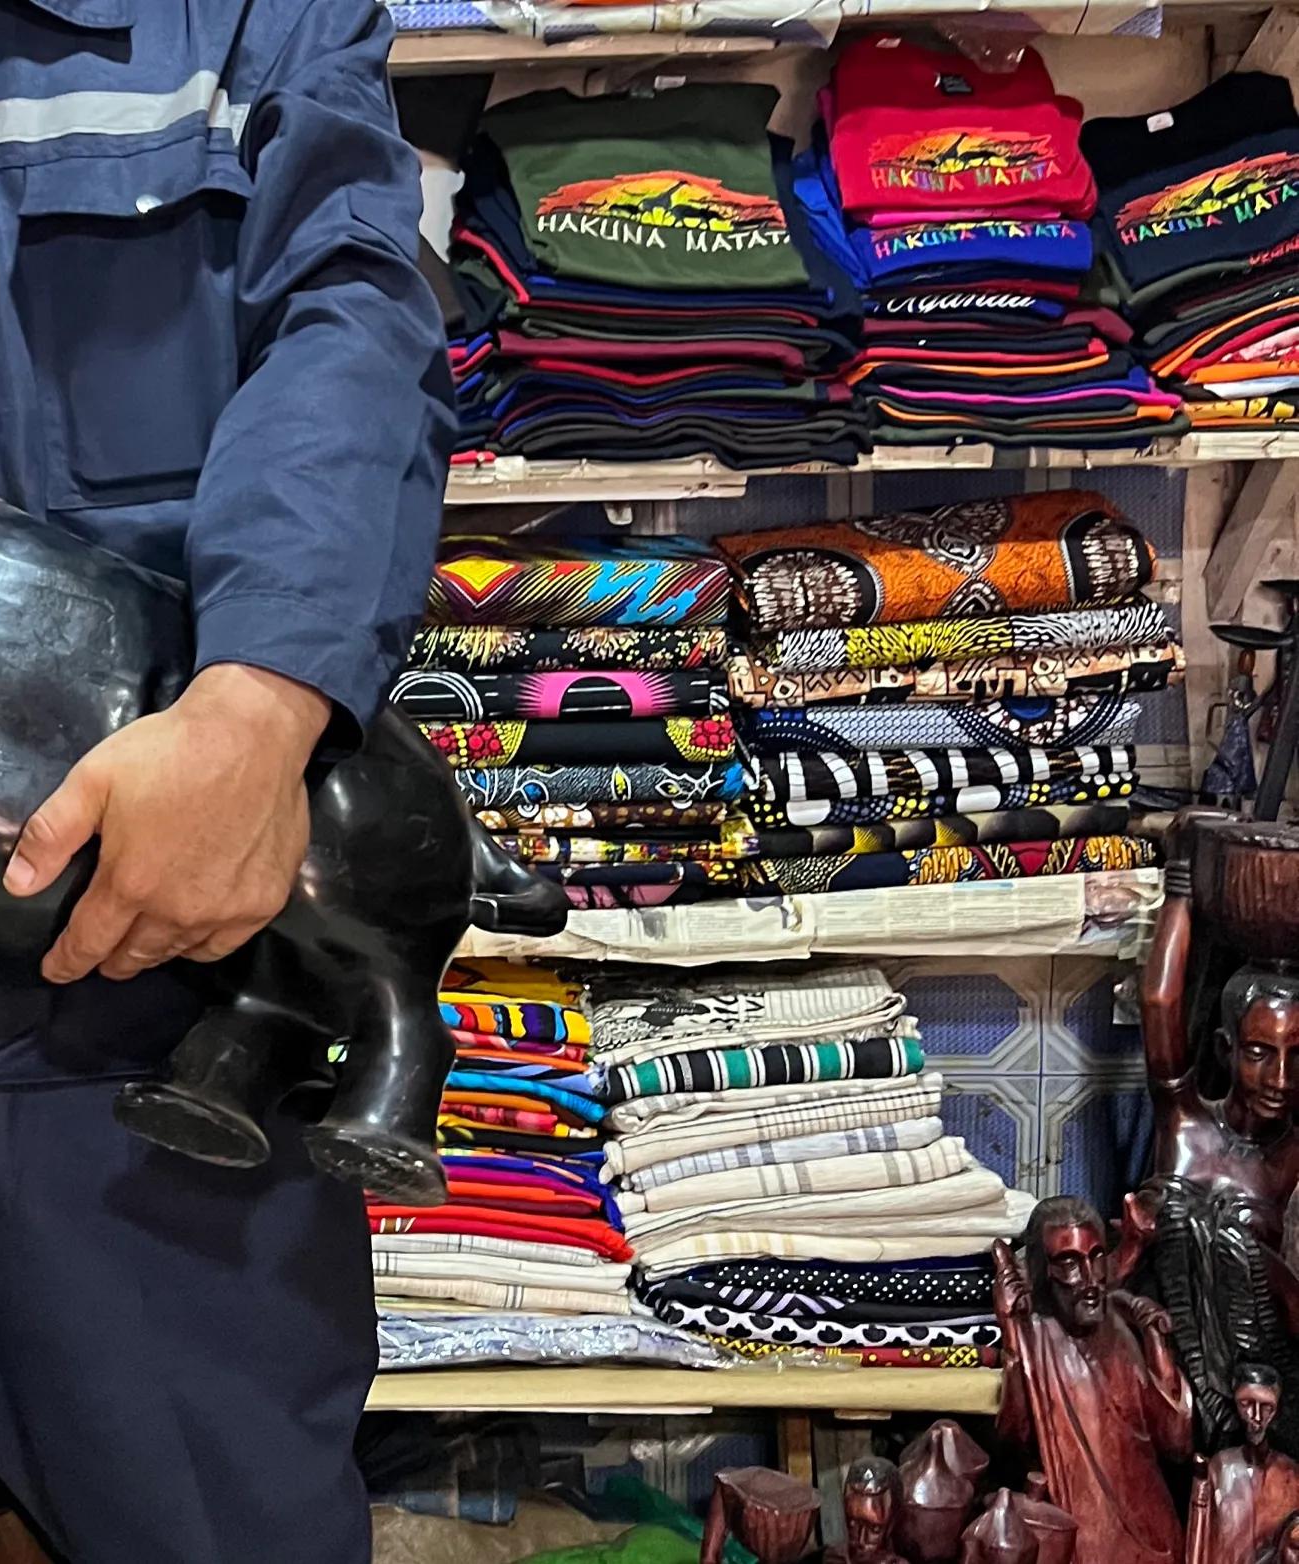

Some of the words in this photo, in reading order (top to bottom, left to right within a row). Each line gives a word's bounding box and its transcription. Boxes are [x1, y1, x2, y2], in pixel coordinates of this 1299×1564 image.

[871, 166, 965, 192] HAKUNA
[975, 161, 1062, 187] MATATA
[537, 212, 667, 249] HAKUNA
[685, 229, 791, 253] MATAT
[1120, 214, 1223, 246] HAKUNA
[1233, 180, 1299, 224] MATA
[874, 227, 976, 260] HAKUNA
[989, 223, 1077, 240] MATATA
